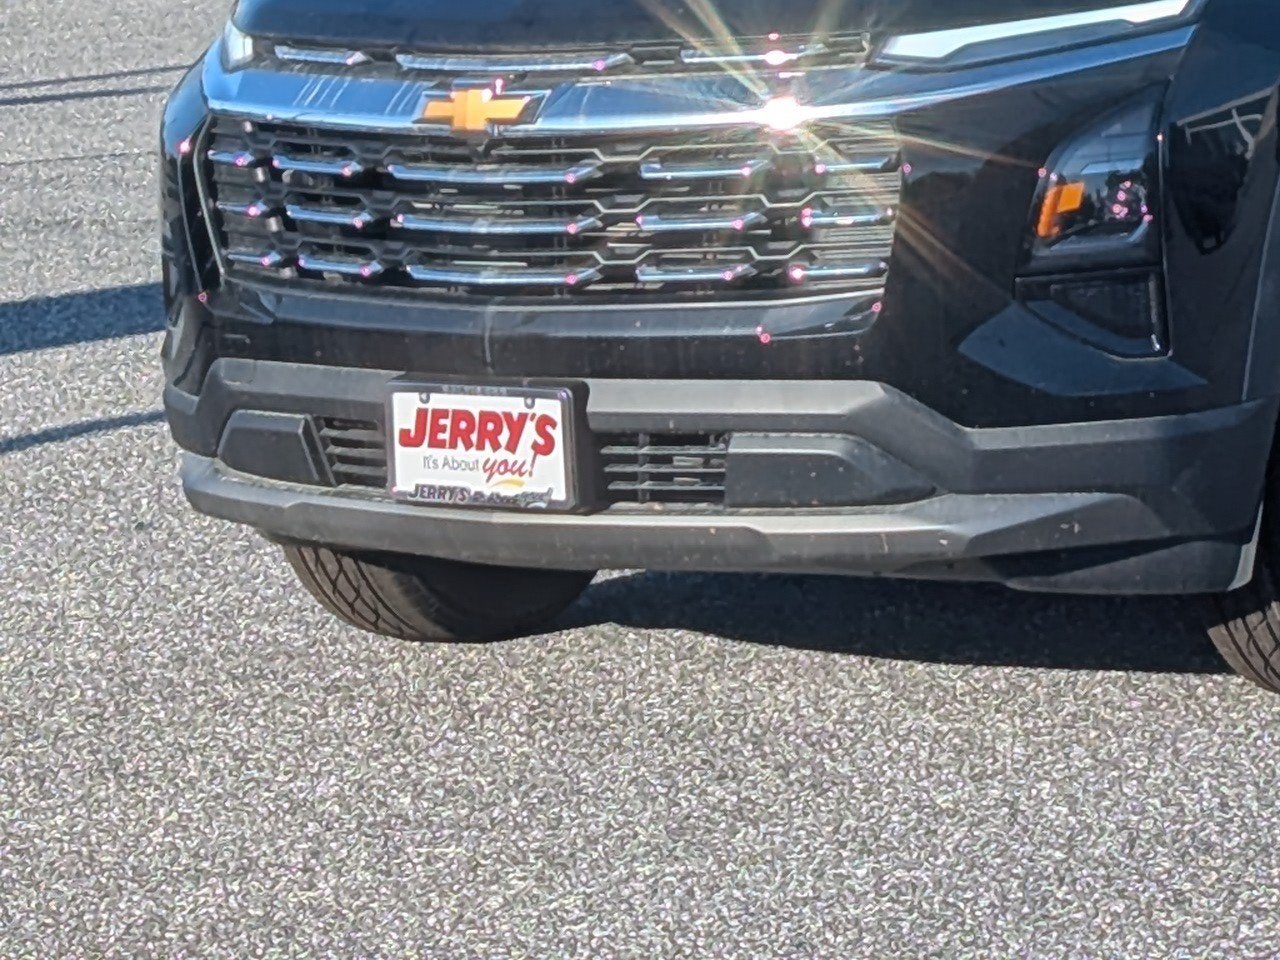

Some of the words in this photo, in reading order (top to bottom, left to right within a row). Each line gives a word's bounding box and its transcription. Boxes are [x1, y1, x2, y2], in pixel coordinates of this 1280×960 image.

[398, 407, 558, 456] JERRY'S
[441, 455, 479, 471] About
[482, 451, 537, 483] you!
